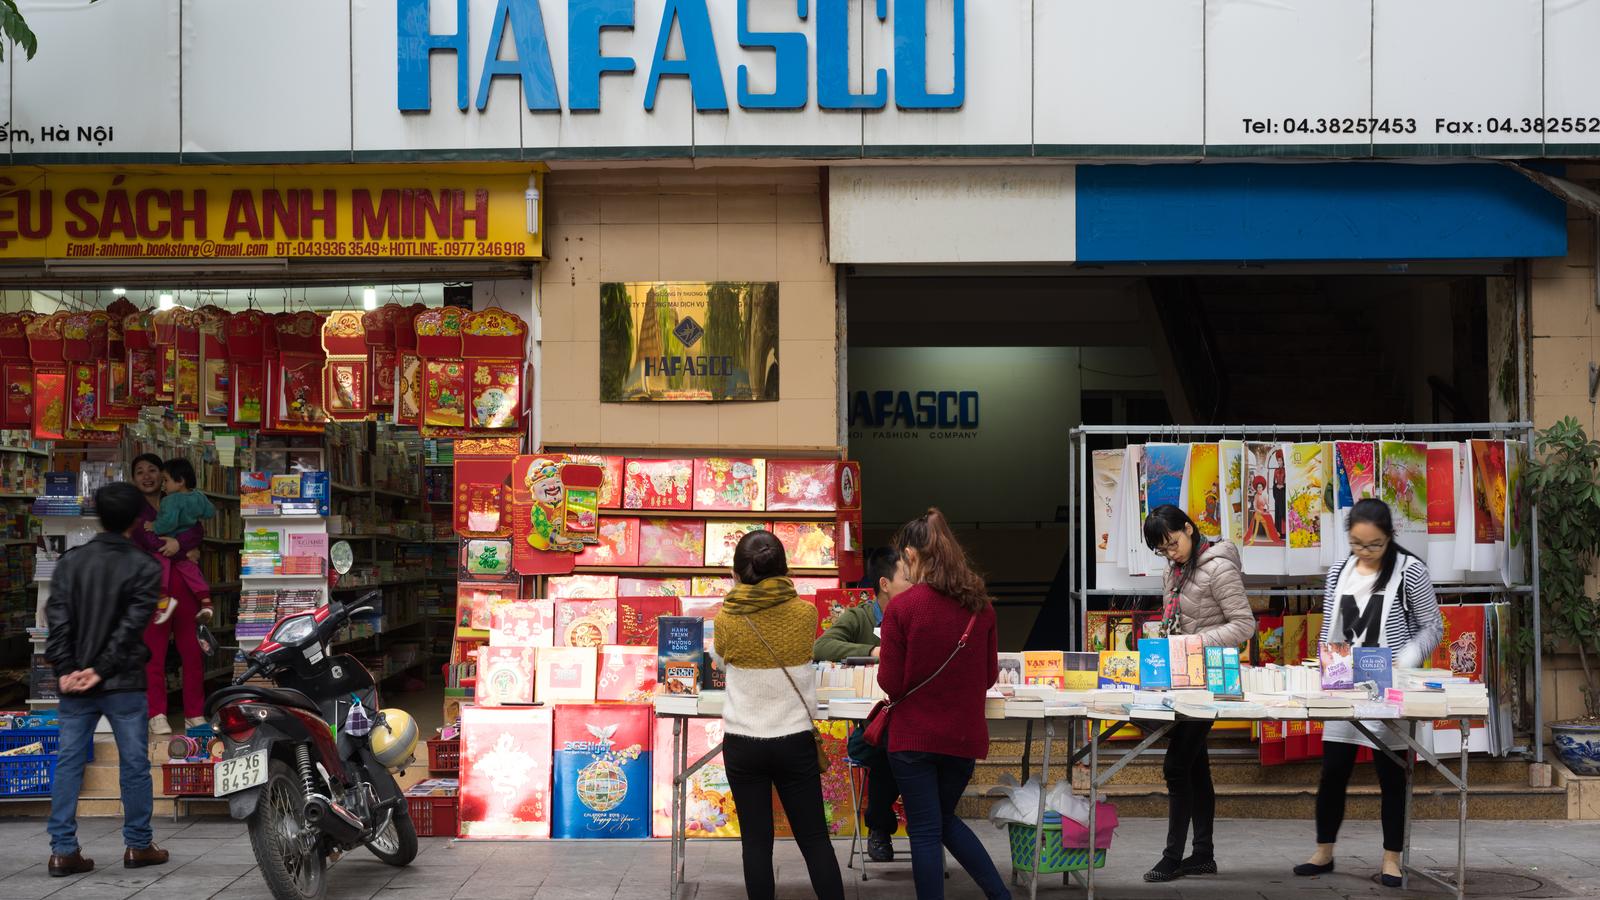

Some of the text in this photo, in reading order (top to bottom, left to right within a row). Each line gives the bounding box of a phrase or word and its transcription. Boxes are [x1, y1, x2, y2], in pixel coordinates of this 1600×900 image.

[397, 0, 965, 113] HAFASCO
[41, 124, 70, 142] Hà
[77, 125, 114, 147] Nội
[1243, 117, 1600, 134] Tel: 04.38257453 Fax: 04.382552
[64, 174, 208, 240] SÁCH
[223, 188, 338, 241] ANH
[352, 188, 489, 240] MINH
[644, 356, 733, 377] HAFASCO
[848, 390, 979, 429] AFASCO
[872, 431, 919, 440] FASHION
[929, 431, 978, 440] COMPANY
[222, 754, 260, 777] 37-X6
[222, 768, 260, 792] 8457
